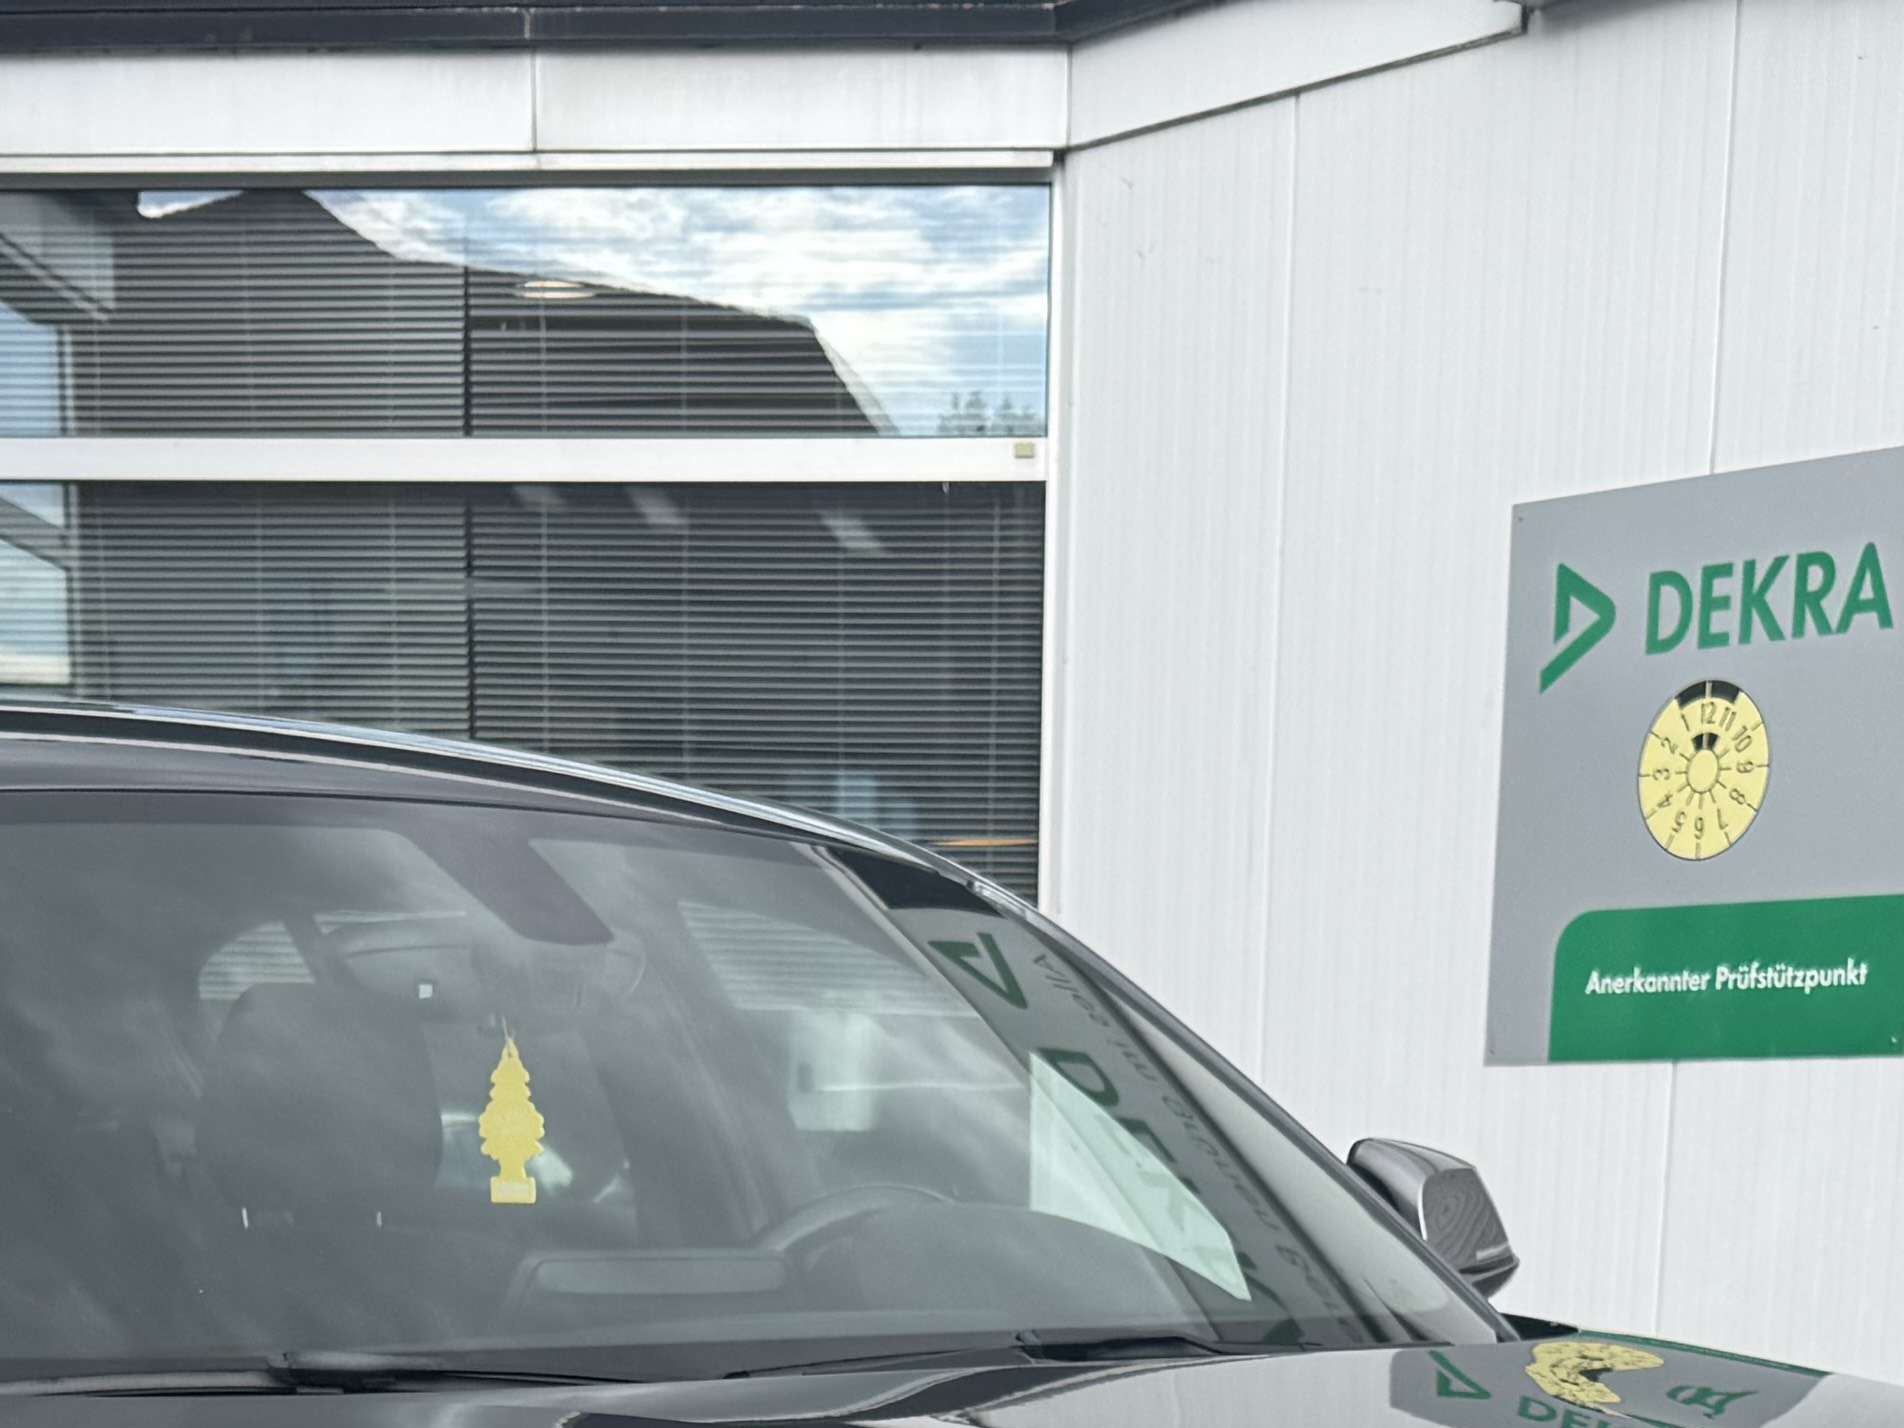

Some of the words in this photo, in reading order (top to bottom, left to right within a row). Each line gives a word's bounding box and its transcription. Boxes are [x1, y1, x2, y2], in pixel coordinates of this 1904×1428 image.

[1644, 541, 1894, 656] DEKRA
[1700, 700, 1717, 724] 12
[1585, 964, 1711, 995] Anerkannter
[1714, 957, 1869, 995] Prüfstützpunkt
